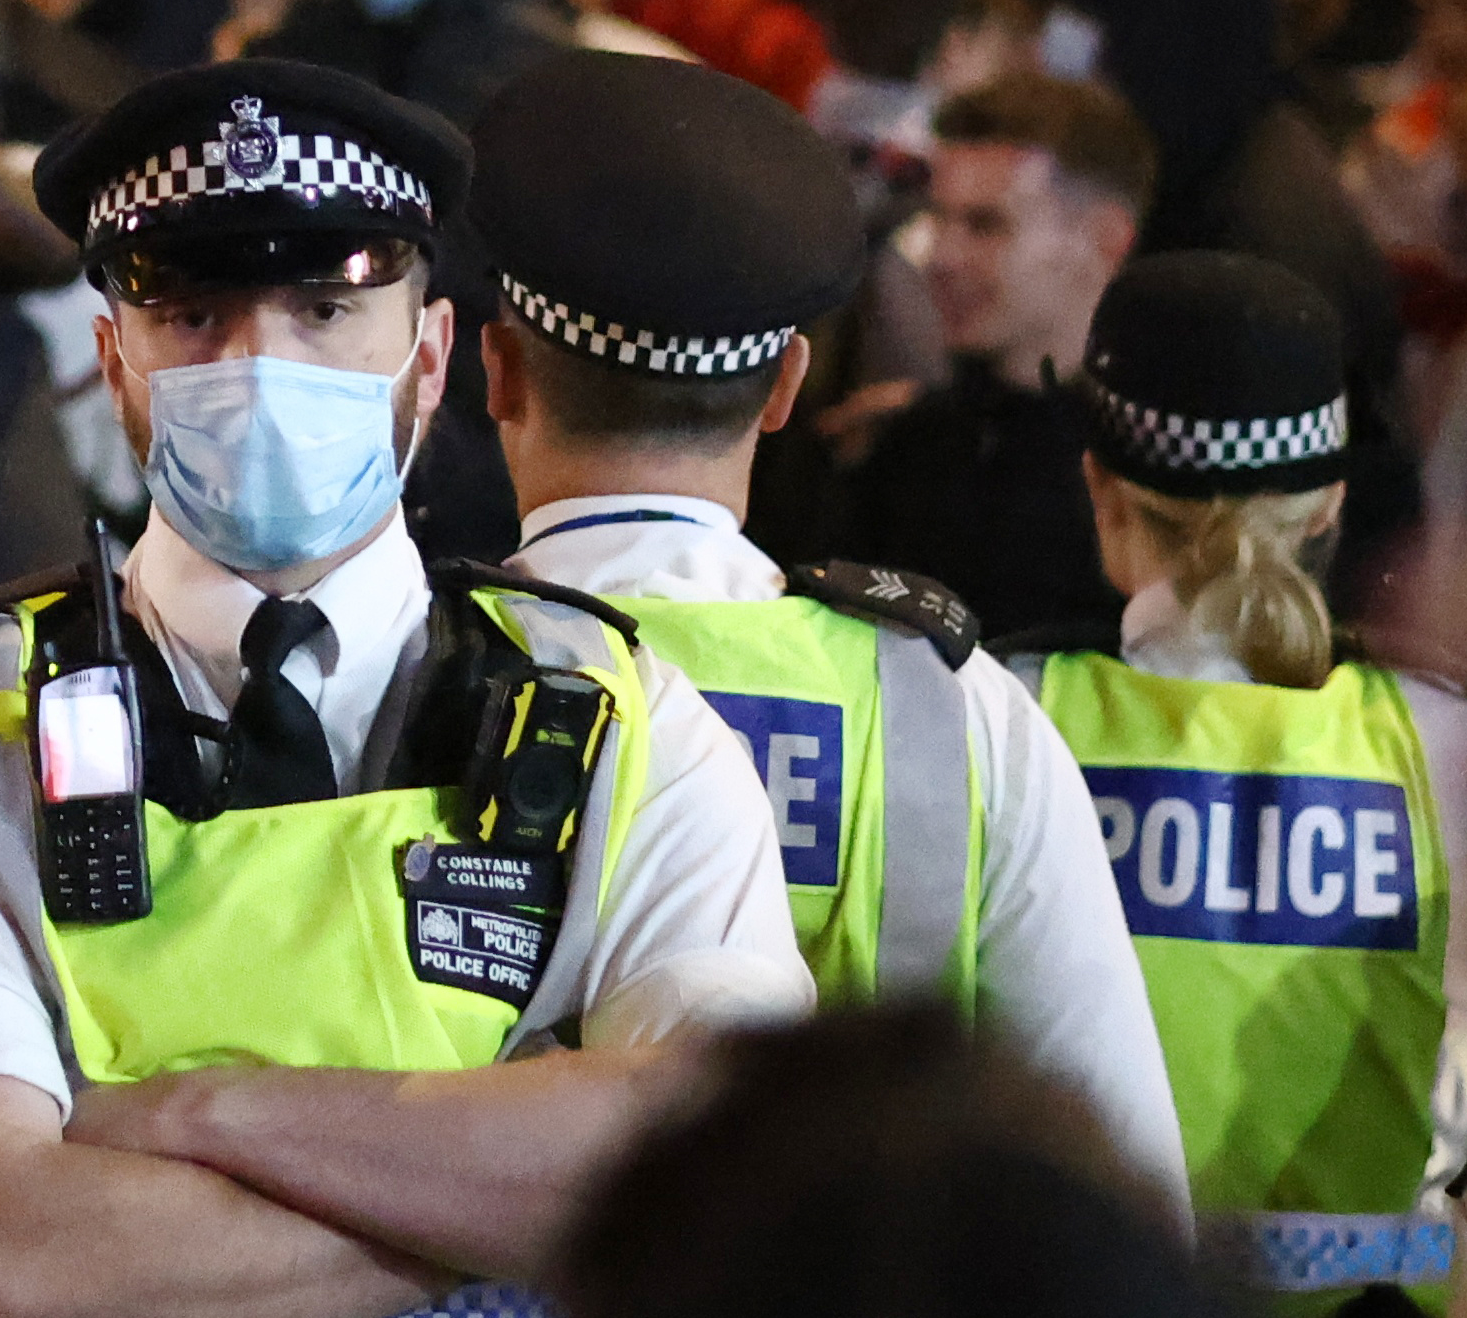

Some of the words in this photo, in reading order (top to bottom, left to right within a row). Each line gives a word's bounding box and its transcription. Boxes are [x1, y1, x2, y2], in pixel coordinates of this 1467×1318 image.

[729, 729, 820, 847] E
[437, 856, 532, 875] CONSTABLE
[1092, 797, 1402, 918] POLICE
[447, 872, 526, 890] COLLINGS
[484, 932, 538, 960] POLICE
[420, 948, 483, 977] POLICE
